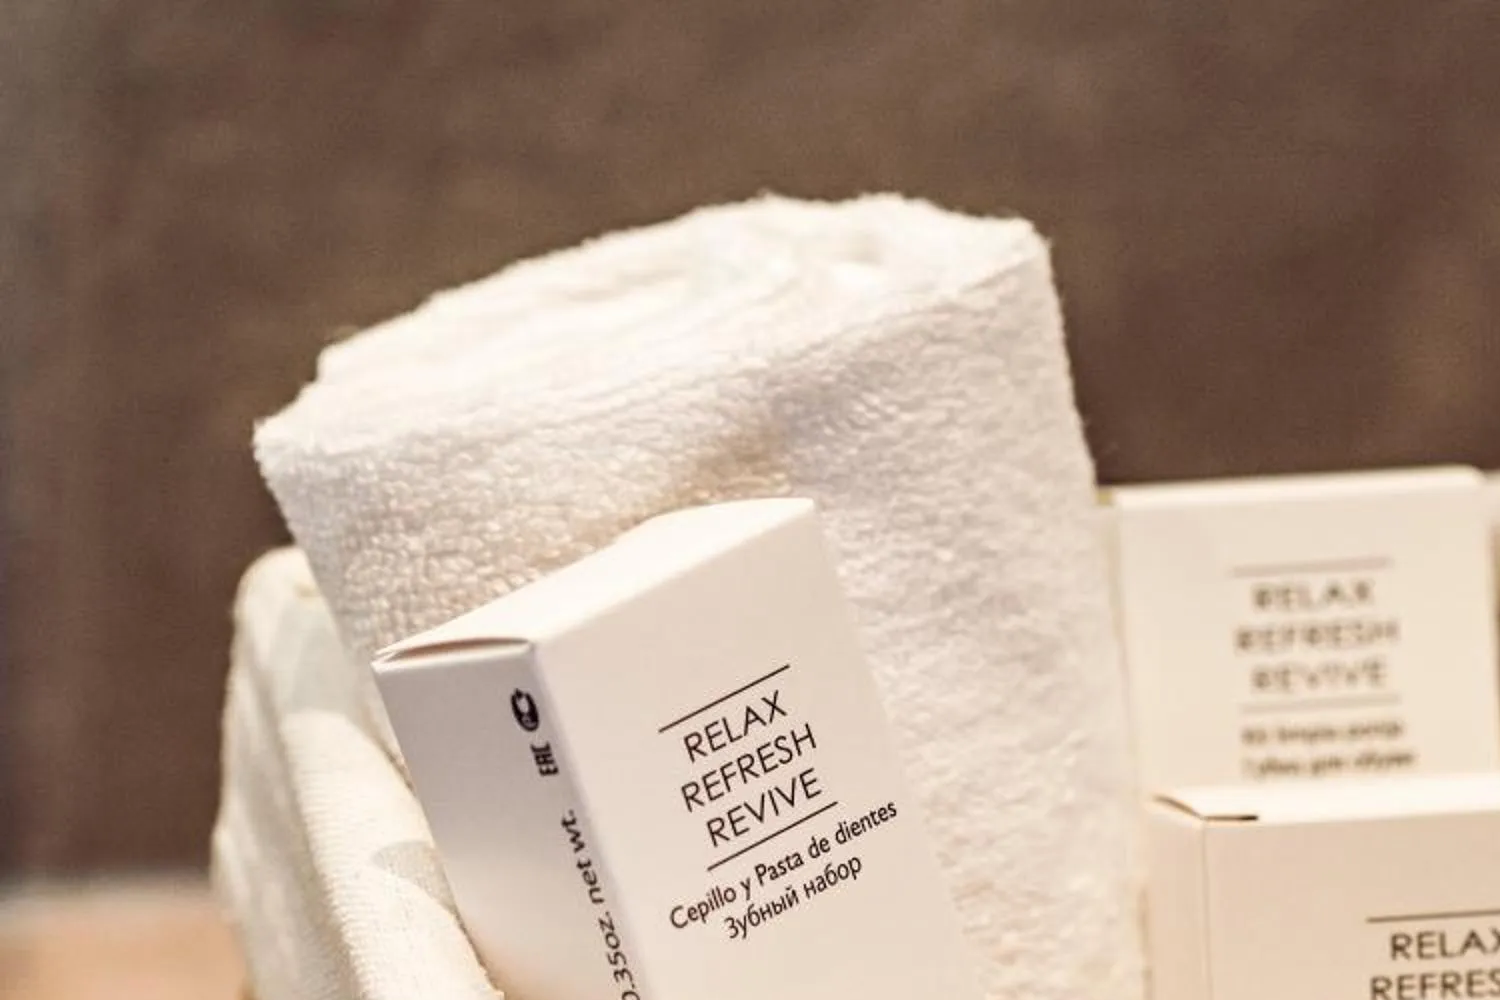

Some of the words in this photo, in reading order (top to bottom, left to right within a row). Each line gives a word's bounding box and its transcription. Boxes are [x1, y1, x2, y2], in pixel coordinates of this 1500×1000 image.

[1253, 579, 1375, 612] RELAX
[1234, 619, 1400, 654] REFRESH
[1250, 658, 1387, 692] REVIVE
[683, 690, 787, 763] RELAX
[681, 723, 816, 812] REFRESH
[561, 809, 585, 853] wt.
[707, 768, 822, 847] REVIVE
[576, 859, 604, 904] net
[670, 885, 737, 928] Cepillo
[740, 877, 751, 900] y
[754, 852, 804, 886] Pasta
[808, 836, 831, 859] de
[835, 801, 897, 845] dientes
[724, 885, 801, 939] Зубный
[803, 856, 862, 900] набор
